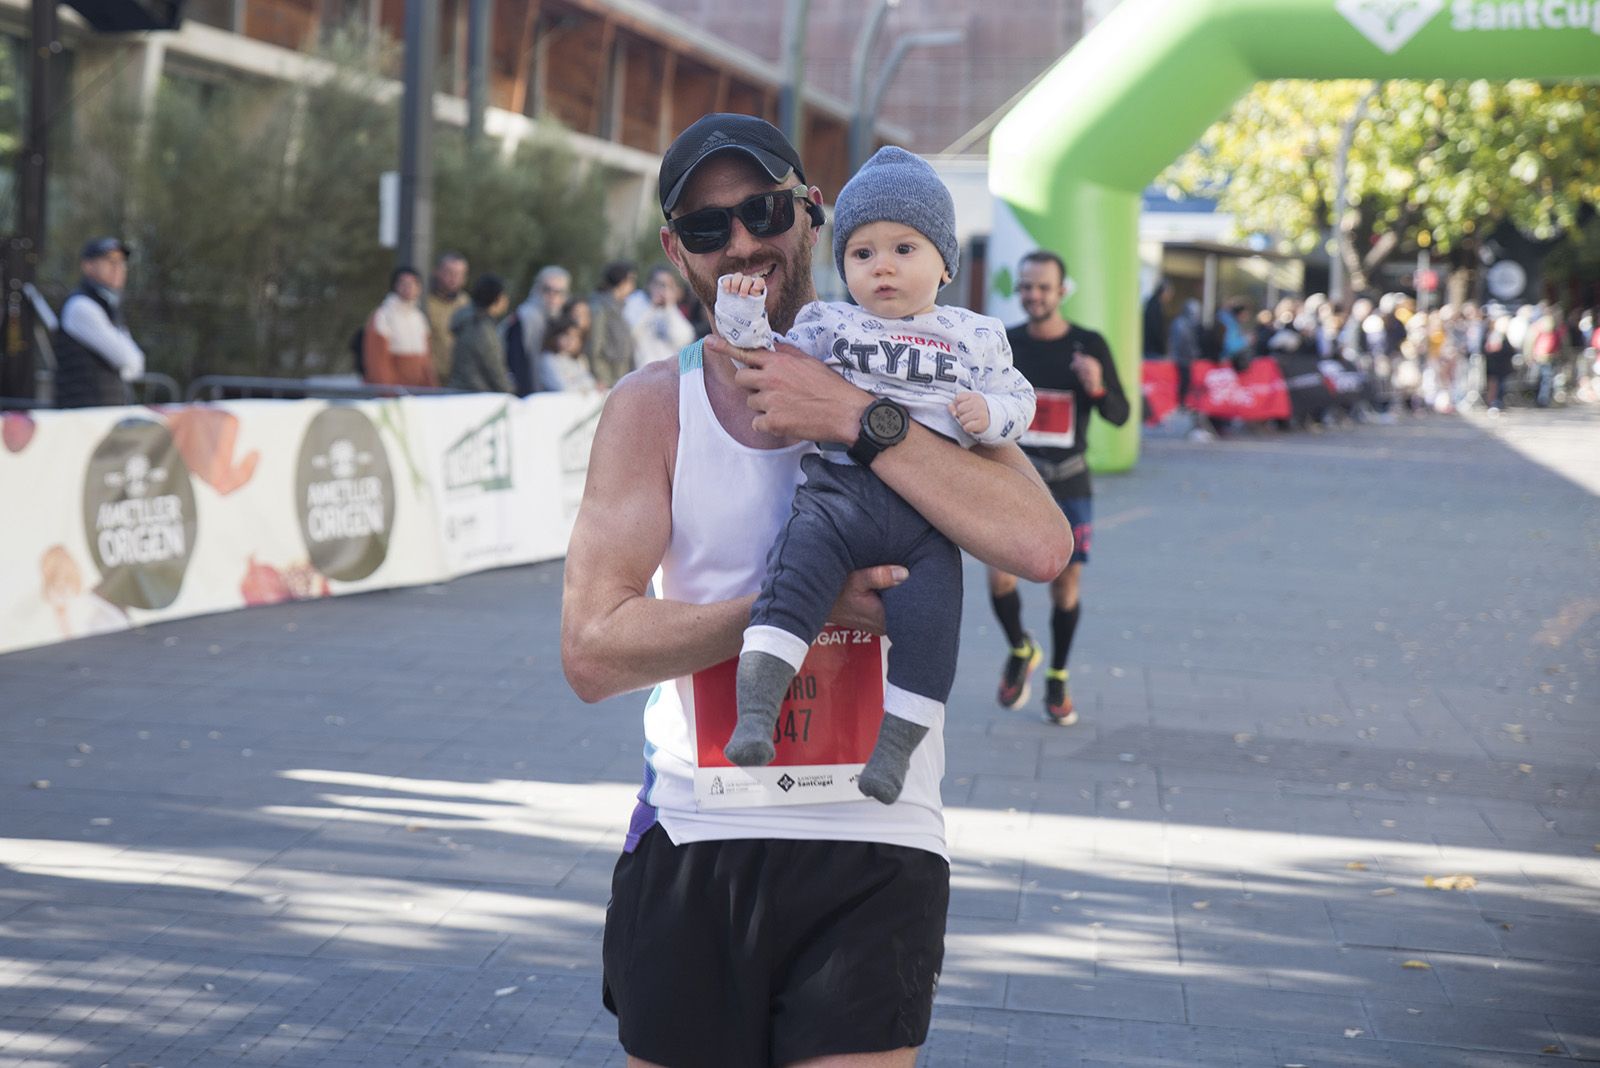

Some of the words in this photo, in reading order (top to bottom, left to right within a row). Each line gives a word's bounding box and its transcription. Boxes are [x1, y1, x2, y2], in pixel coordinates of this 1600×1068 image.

[832, 338, 958, 384] STYLE
[890, 335, 951, 353] URBAN
[307, 504, 384, 541] ORIGEN
[98, 524, 186, 568] ORIGEN
[811, 630, 850, 646] GAT
[852, 630, 872, 643] 22
